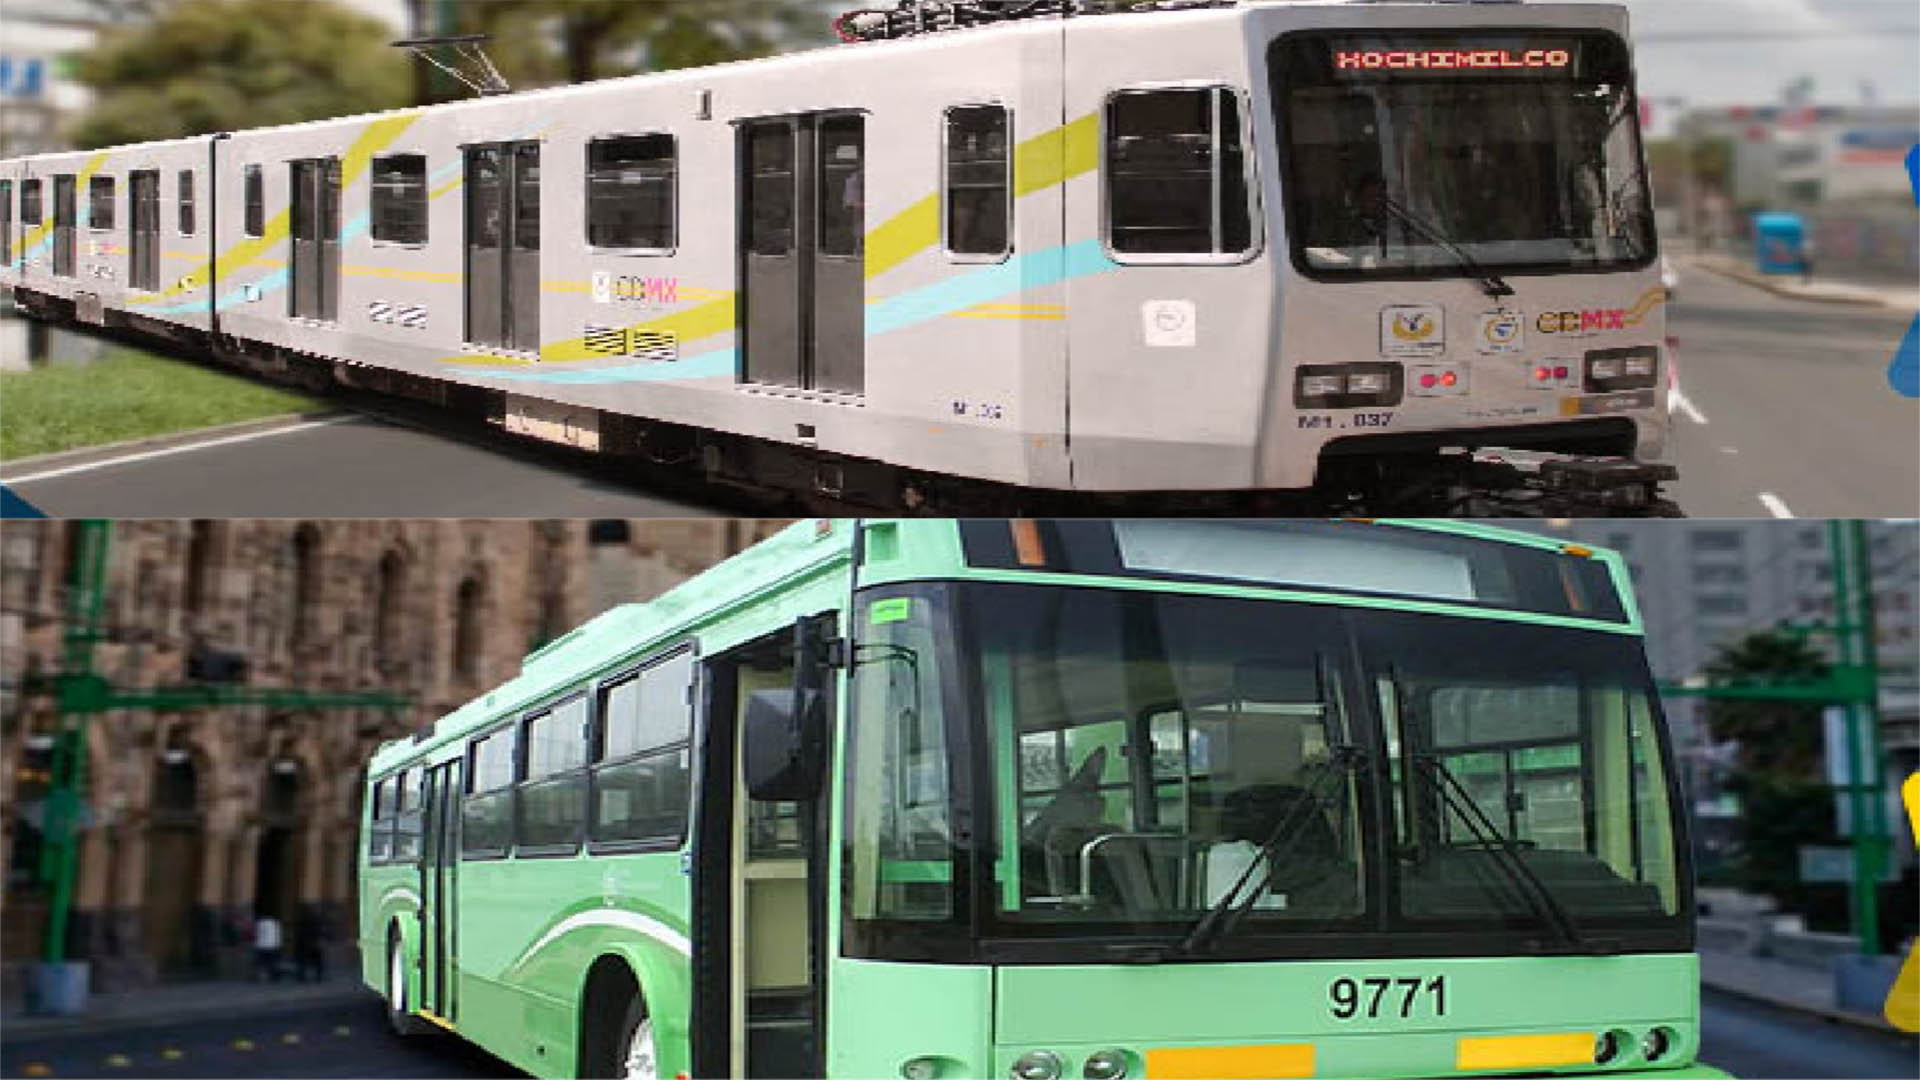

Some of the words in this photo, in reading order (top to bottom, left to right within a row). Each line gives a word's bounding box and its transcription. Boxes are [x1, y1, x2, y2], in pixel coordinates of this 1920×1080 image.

[617, 276, 677, 303] CDMX
[1536, 310, 1624, 333] CDMX
[1330, 975, 1445, 1018] 9771
